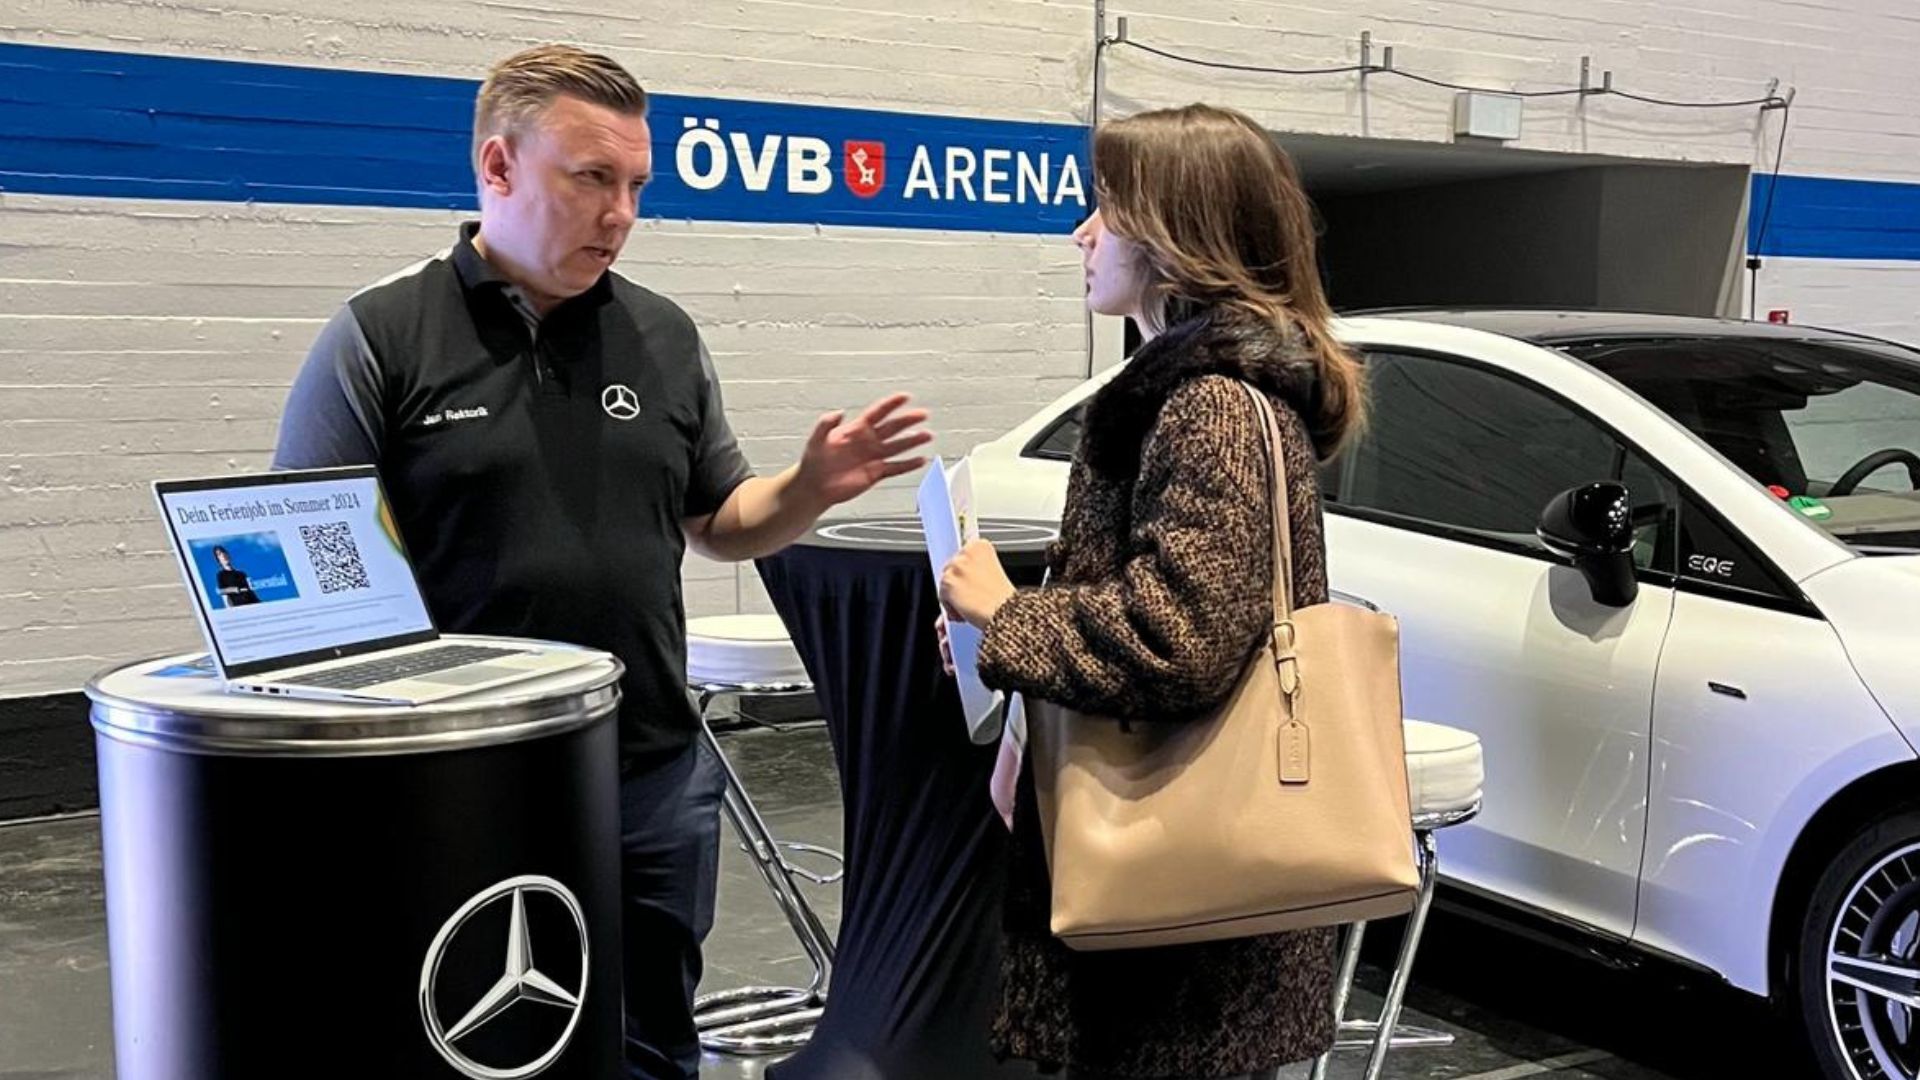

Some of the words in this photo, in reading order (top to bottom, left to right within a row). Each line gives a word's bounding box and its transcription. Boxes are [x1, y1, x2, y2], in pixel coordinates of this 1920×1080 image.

[676, 116, 833, 195] ÖVB
[903, 144, 1087, 207] ARENA
[177, 505, 209, 524] Dein
[208, 502, 267, 521] Ferienjob
[267, 500, 285, 516] im
[283, 497, 331, 514] Sommer
[331, 492, 361, 510] 2024
[1688, 554, 1735, 577] EQE
